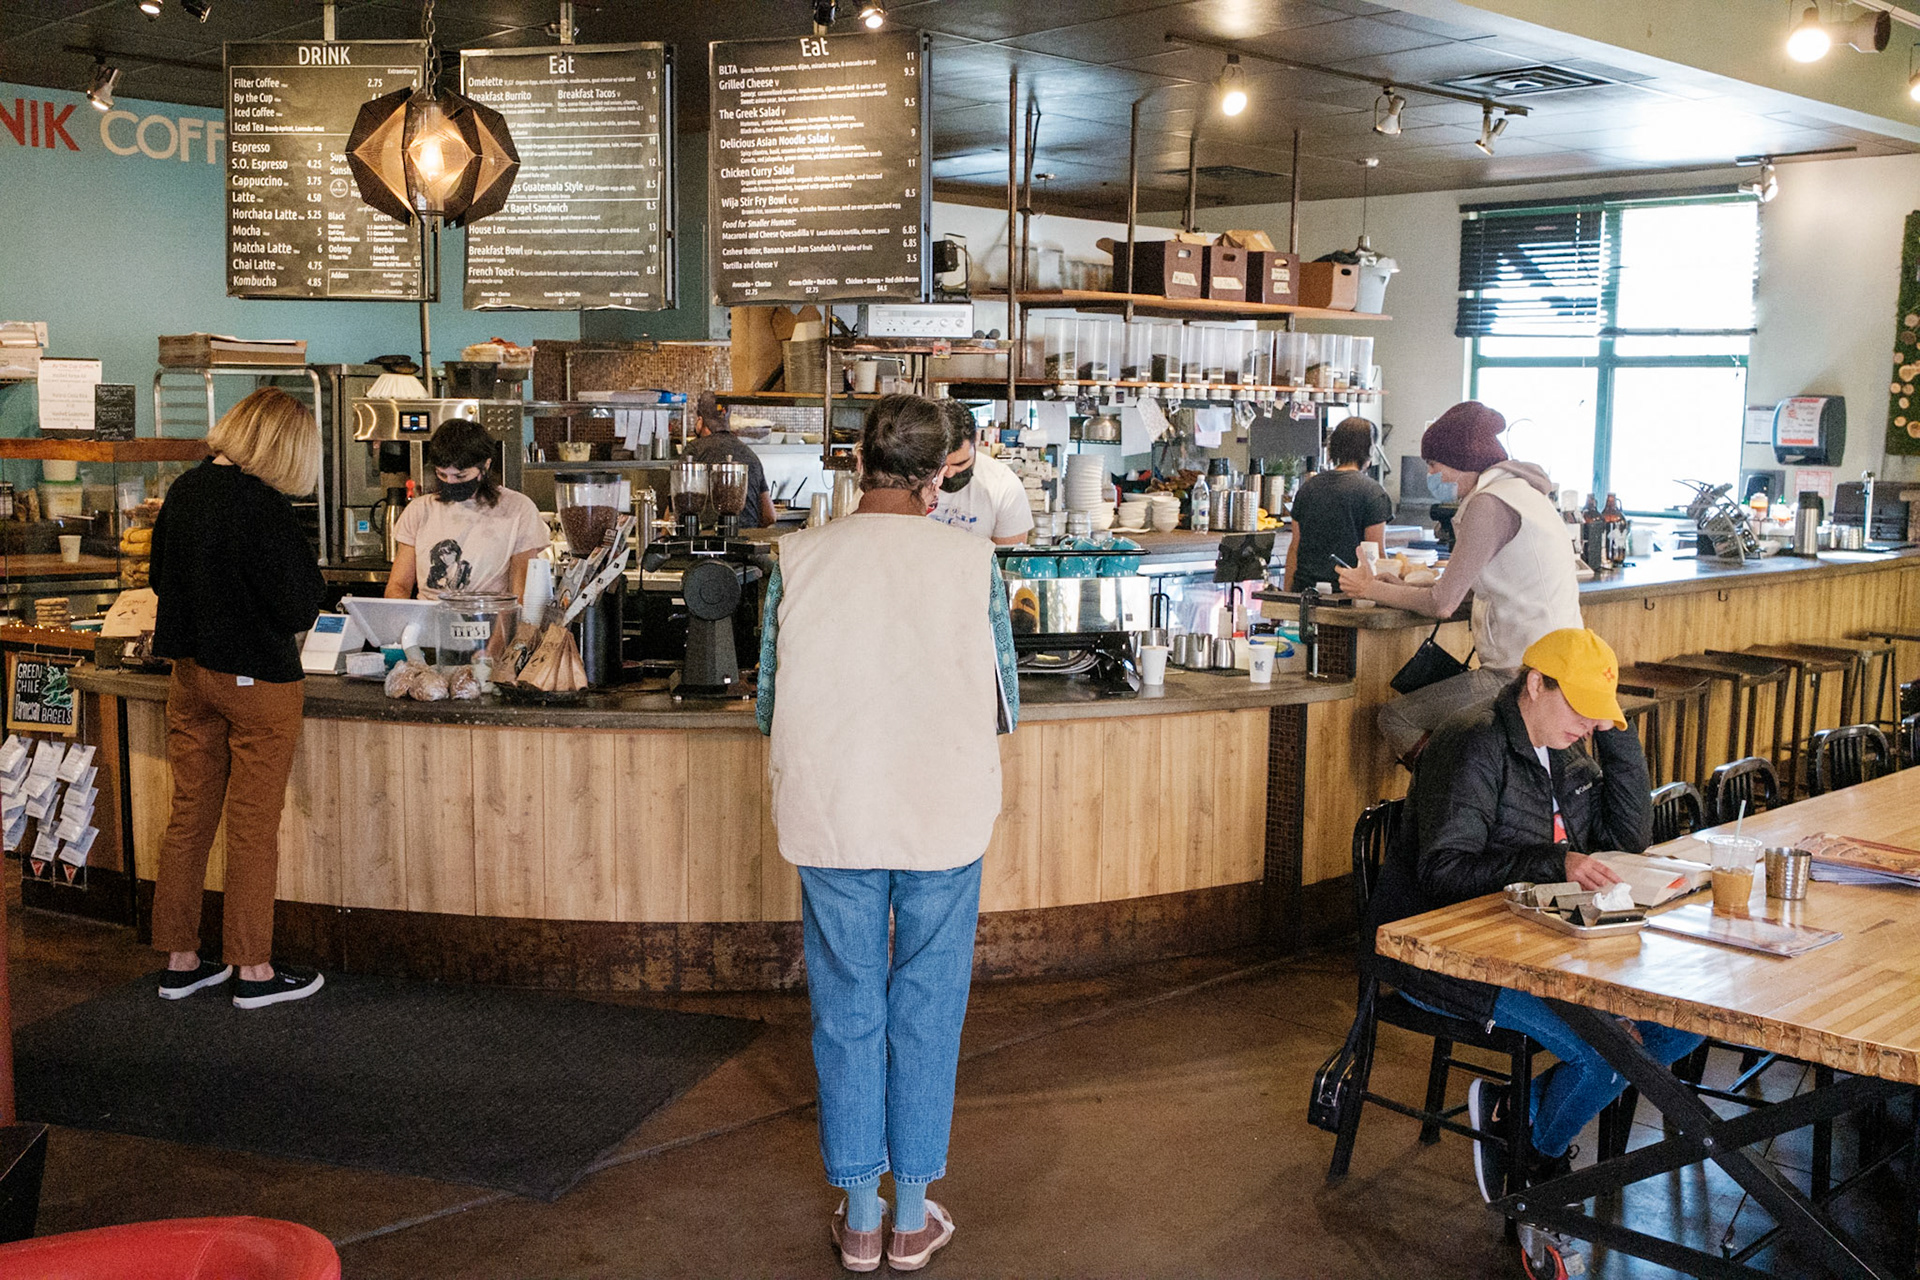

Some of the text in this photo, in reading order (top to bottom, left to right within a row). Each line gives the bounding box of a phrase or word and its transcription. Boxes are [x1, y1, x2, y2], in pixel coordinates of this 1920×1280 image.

[800, 38, 829, 57] Eat
[298, 46, 351, 65] DRINK
[906, 52, 914, 60] 11
[549, 55, 575, 74] Eat
[718, 65, 738, 75] BLTA
[646, 71, 656, 80] 9.5
[904, 68, 915, 76] 9.5
[234, 78, 418, 88] Filter Coffee 2.75 4
[468, 76, 504, 86] Omelette
[718, 78, 774, 90] Grilled Cheese
[558, 88, 616, 99] Breakfast Tacos
[652, 86, 657, 94] 9
[234, 92, 273, 104] By the Cup
[468, 91, 532, 101] Breakfast Burrito
[904, 98, 916, 106] 9.5
[234, 106, 275, 118] Iced Coffee
[719, 106, 780, 119] The Greek Salad
[649, 114, 656, 123] 10
[234, 122, 264, 132] Iced Tea
[911, 128, 916, 136] 9
[649, 136, 656, 145] 10
[720, 132, 829, 149] Delicious Asian Noodle Salad
[232, 142, 322, 154] Espresso 3
[232, 158, 322, 172] S.O. Espresso 4.25
[648, 158, 656, 166] 12
[908, 158, 916, 168] 11
[721, 164, 794, 178] Chicken Curry Salad
[232, 174, 322, 188] Cappuccino 3.75
[646, 180, 656, 188] 8.5
[522, 182, 563, 192] Guatemala
[564, 181, 584, 194] Style
[904, 188, 916, 198] 8.5
[232, 192, 322, 202] Latte 4.50
[722, 194, 787, 209] Wija Stir Fry Bowl
[510, 204, 532, 215] Bagel
[533, 202, 568, 214] Sandwich
[646, 202, 656, 210] 8.5
[232, 208, 322, 220] Horchata Latte 5.25
[328, 211, 392, 222] Black Green
[649, 222, 656, 232] 13
[722, 218, 797, 229] Food for Smaller Humans:
[232, 224, 260, 236] Mocha
[317, 226, 322, 236] 5
[468, 226, 492, 234] House
[493, 225, 506, 234] Lox
[748, 231, 759, 239] and
[780, 228, 810, 238] Quesadilla
[902, 225, 917, 234] 6.85
[233, 241, 322, 254] Matcha Latte 6
[649, 244, 656, 253] 10
[902, 238, 917, 248] 6.85
[328, 244, 394, 254] Oolong Herbal
[468, 246, 504, 256] Breakfast
[505, 245, 524, 256] Bowl
[744, 247, 762, 256] Butter,
[810, 244, 836, 252] Sandwich
[906, 254, 918, 262] 3.5
[232, 258, 322, 270] Chai Latte 4.75
[744, 261, 754, 269] and
[754, 260, 773, 268] cheese
[468, 266, 494, 276] French
[494, 267, 514, 276] Toast
[646, 266, 656, 274] 8.5
[233, 275, 322, 287] Kombucha 4.85
[452, 624, 486, 638] TIPS!
[18, 663, 42, 679] GREEN
[16, 680, 40, 693] CHILE
[41, 708, 72, 724] BAGELS
